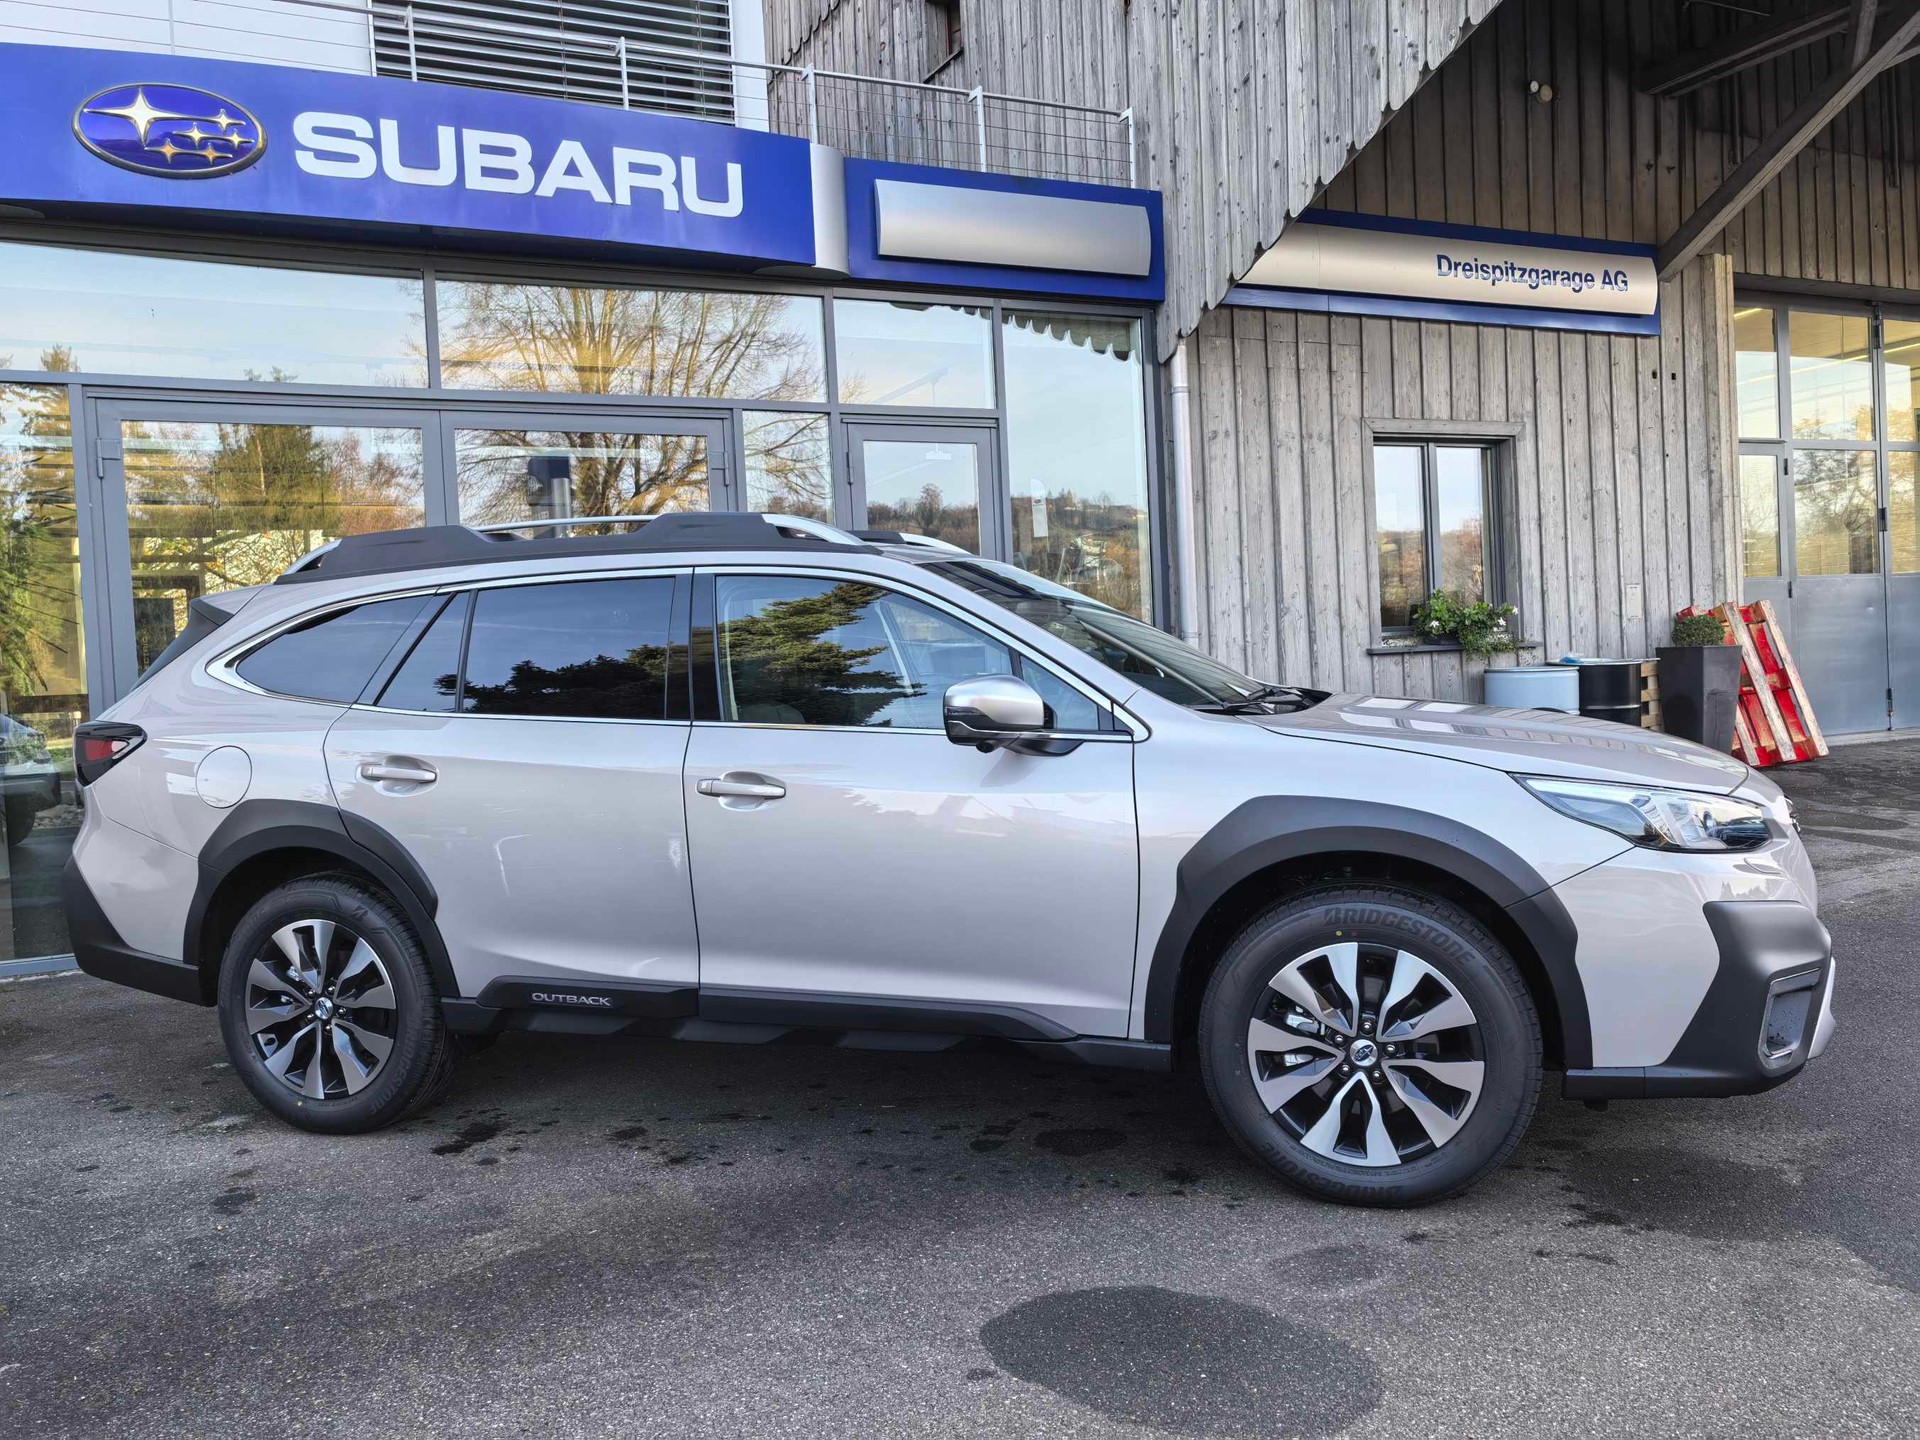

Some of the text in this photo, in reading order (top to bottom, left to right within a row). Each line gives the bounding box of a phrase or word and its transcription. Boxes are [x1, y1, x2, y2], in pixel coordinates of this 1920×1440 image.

[292, 111, 744, 218] SUBARU
[1436, 254, 1629, 294] Dreispitzgarage AG
[1323, 906, 1477, 966] BRIDGESTONE
[531, 992, 612, 1007] OUTBACK
